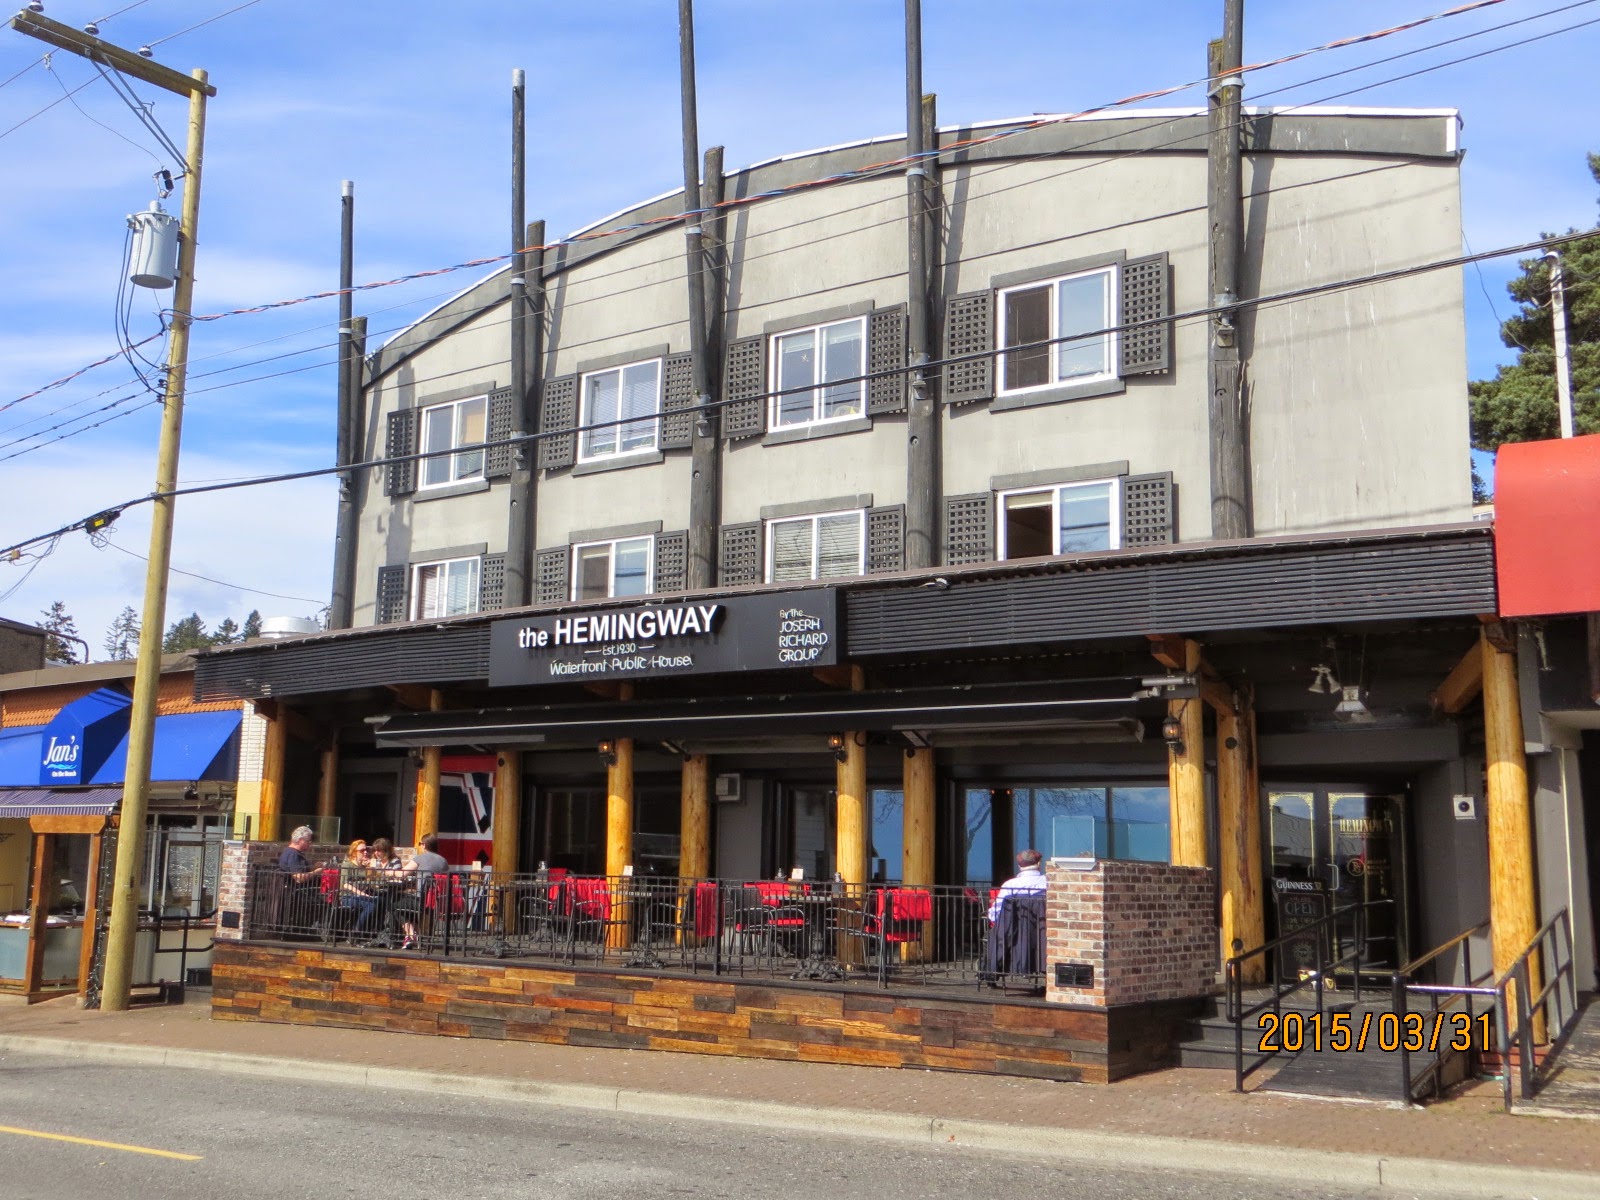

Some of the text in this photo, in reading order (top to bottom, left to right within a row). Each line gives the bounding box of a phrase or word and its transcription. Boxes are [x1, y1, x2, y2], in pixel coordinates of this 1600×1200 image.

[518, 604, 718, 648] the HEMINGWAY
[779, 618, 820, 633] JOSEPH
[779, 632, 828, 648] RICHARD
[778, 647, 819, 662] GROUP
[550, 655, 692, 676] Waterfront Public House
[43, 735, 79, 765] Jan's
[1276, 880, 1313, 890] GUINNESS
